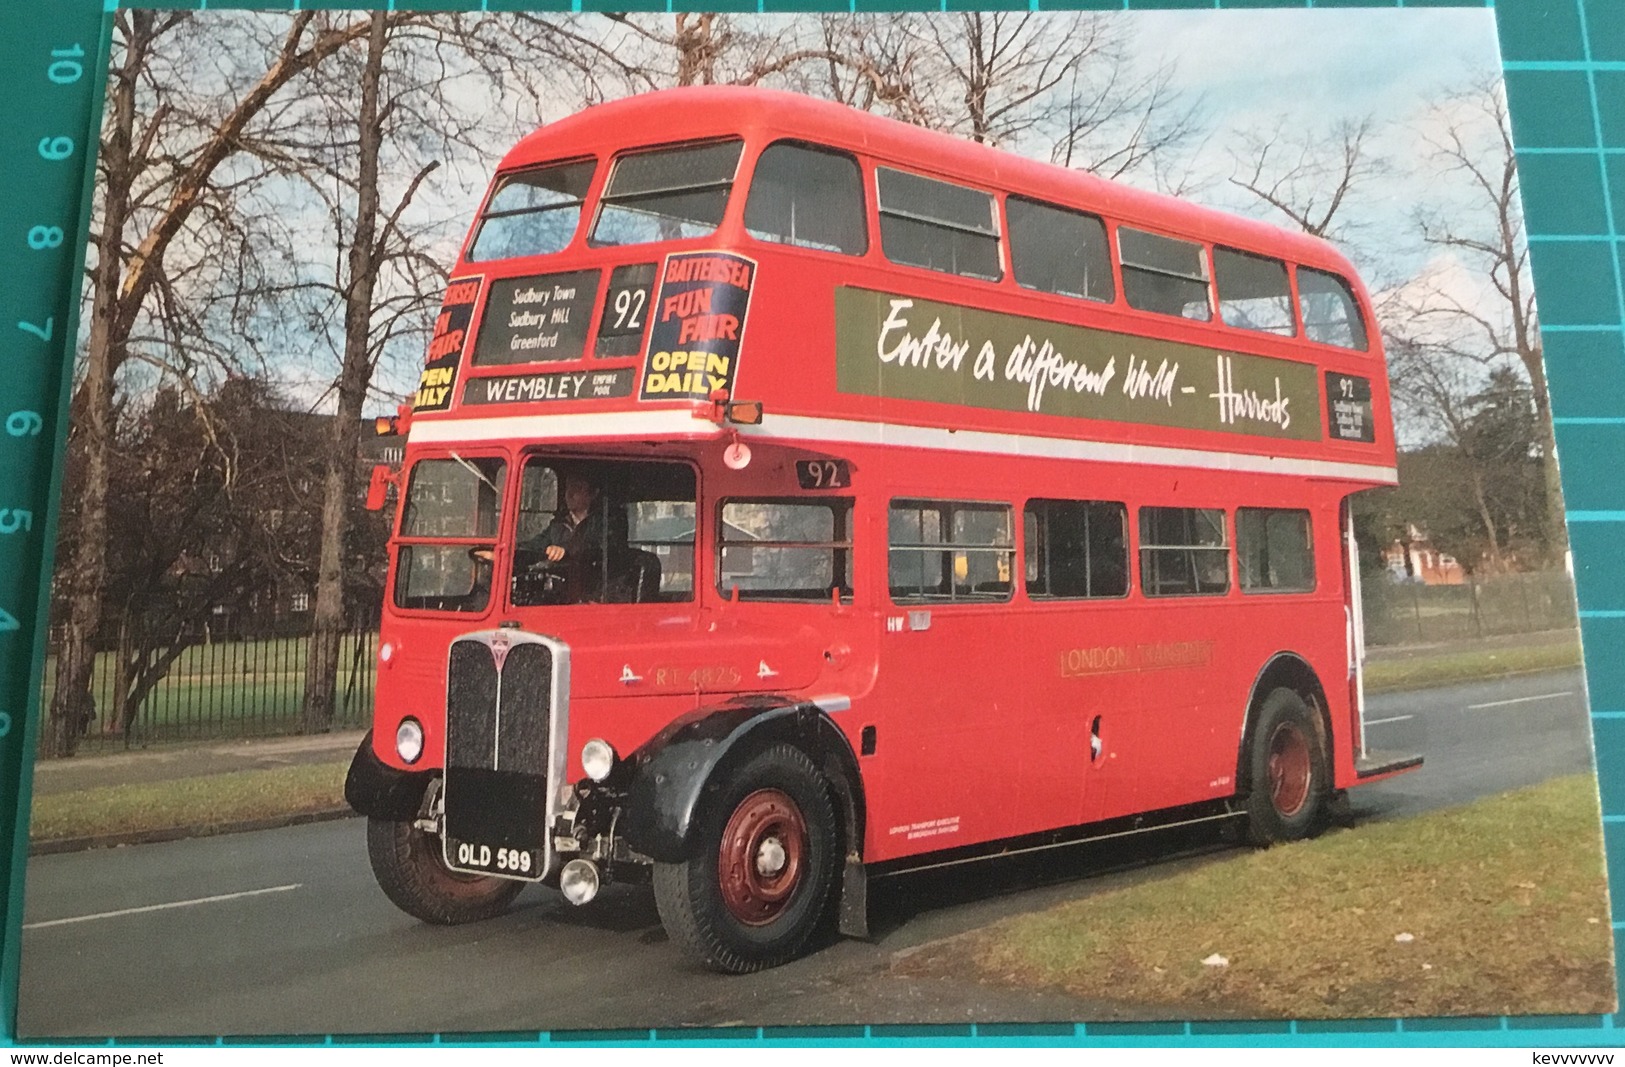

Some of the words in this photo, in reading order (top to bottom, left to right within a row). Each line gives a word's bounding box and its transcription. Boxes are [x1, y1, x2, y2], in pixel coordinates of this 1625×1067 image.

[48, 43, 84, 84] 10
[38, 136, 74, 160] 9
[28, 225, 64, 250] 8
[665, 257, 749, 290] BATTERSEA
[512, 288, 550, 306] Sudbury
[552, 285, 576, 302] Town
[662, 287, 713, 322] FUN
[508, 311, 546, 329] Sudbury
[614, 289, 646, 329] 92
[18, 317, 53, 341] 7
[510, 332, 559, 350] Greenford
[678, 313, 740, 345] FAIR
[652, 351, 730, 375] OPEN
[878, 299, 969, 372] Enter
[973, 340, 995, 381] a
[1005, 334, 1115, 411] different
[1209, 354, 1290, 430] Harrods
[487, 375, 587, 401] WEMBLEY
[592, 374, 617, 385] EMPIRE
[593, 385, 611, 396] POOL
[646, 373, 727, 394] DAILY
[1340, 377, 1354, 397] 92
[6, 410, 42, 436] 6
[808, 462, 841, 487] 92
[0, 508, 32, 534] 5
[1060, 646, 1128, 677] LONDON
[656, 668, 682, 686] RT
[458, 843, 491, 866] OLD
[497, 848, 531, 872] 589
